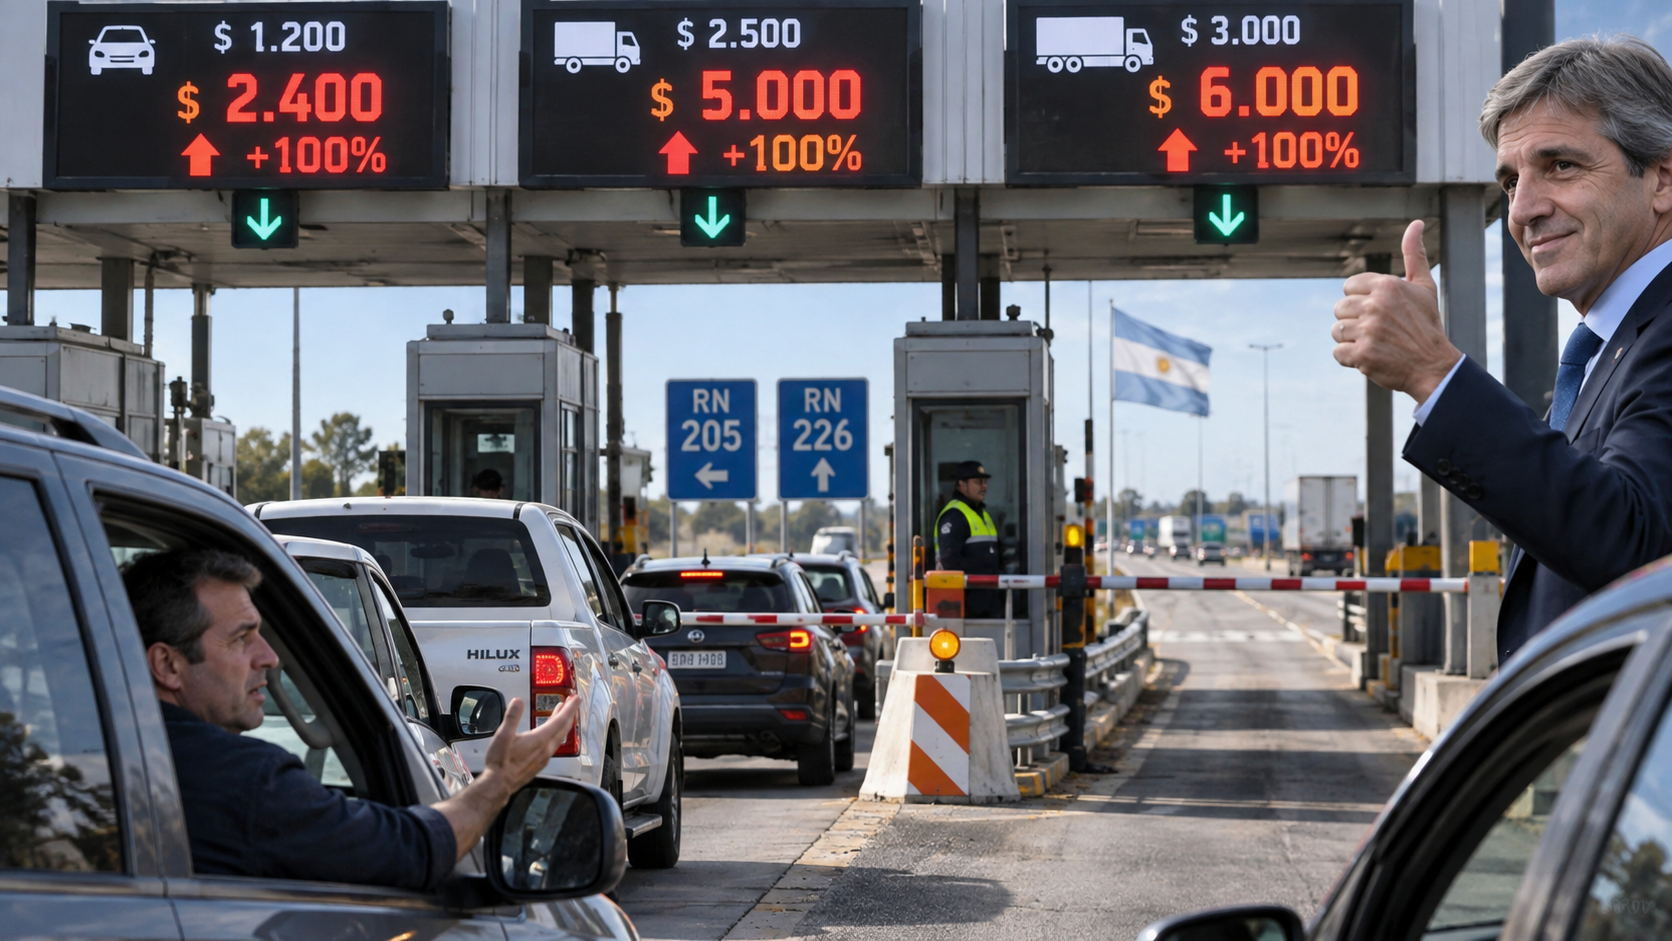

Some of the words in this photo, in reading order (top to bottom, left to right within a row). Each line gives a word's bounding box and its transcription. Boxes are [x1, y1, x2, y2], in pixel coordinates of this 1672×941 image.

[214, 21, 232, 54] $
[251, 21, 345, 52] 1.200
[678, 18, 694, 50] $
[709, 18, 800, 48] 2.500
[1181, 15, 1198, 47] $
[1211, 15, 1300, 45] 3.000
[178, 81, 199, 124] $
[227, 72, 382, 122] 2.400
[651, 78, 673, 121] $
[702, 69, 862, 119] 5.000
[1149, 75, 1172, 118] $
[1200, 65, 1358, 117] 6.000
[247, 136, 386, 173] +100%
[723, 134, 862, 171] +100%
[1224, 131, 1360, 169] +100%
[693, 388, 729, 413] RN
[805, 387, 841, 412] RN
[681, 419, 742, 452] 205
[793, 418, 853, 451] 226
[467, 649, 521, 660] HILUX
